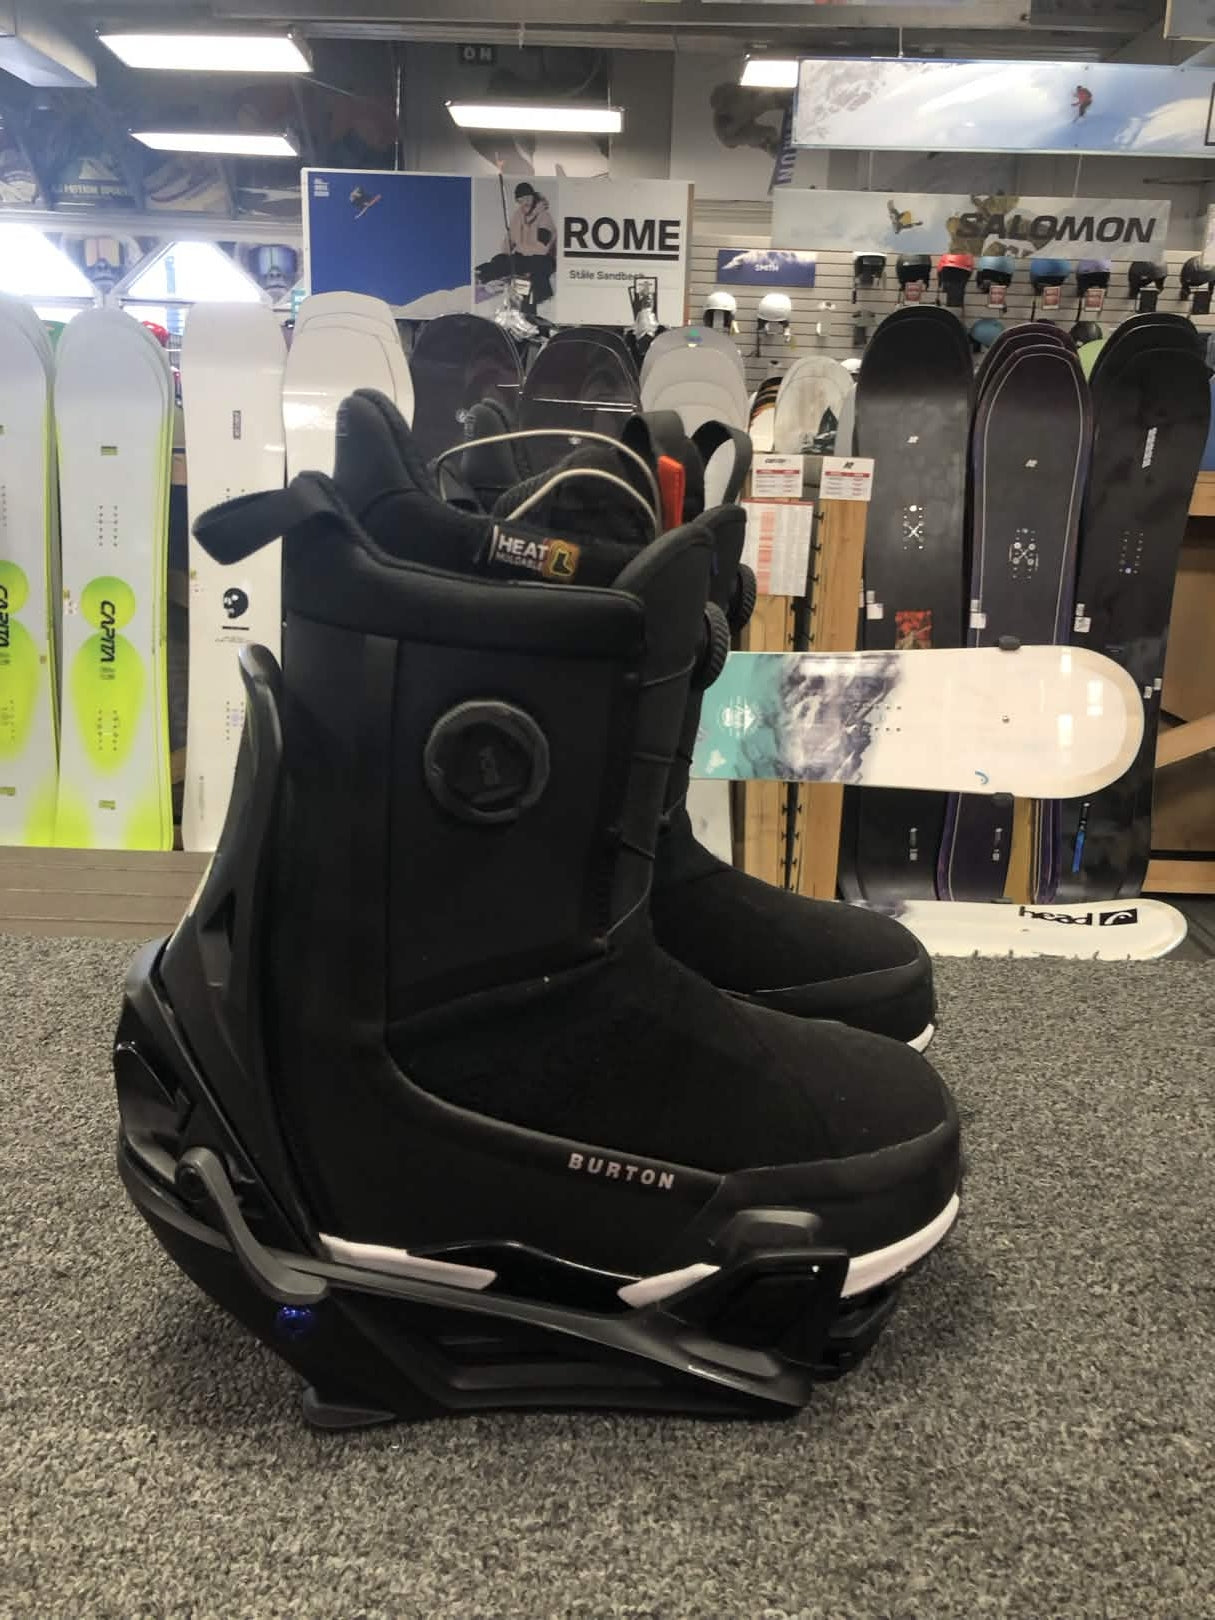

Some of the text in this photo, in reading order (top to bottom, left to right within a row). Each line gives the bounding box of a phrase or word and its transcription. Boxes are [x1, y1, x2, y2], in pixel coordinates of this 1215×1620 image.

[563, 216, 680, 251] ROME
[957, 212, 1157, 243] SALOMON
[498, 534, 549, 561] HEAT
[100, 600, 116, 663] CAPITA
[1019, 905, 1093, 926] head
[568, 1152, 675, 1189] BURTON
